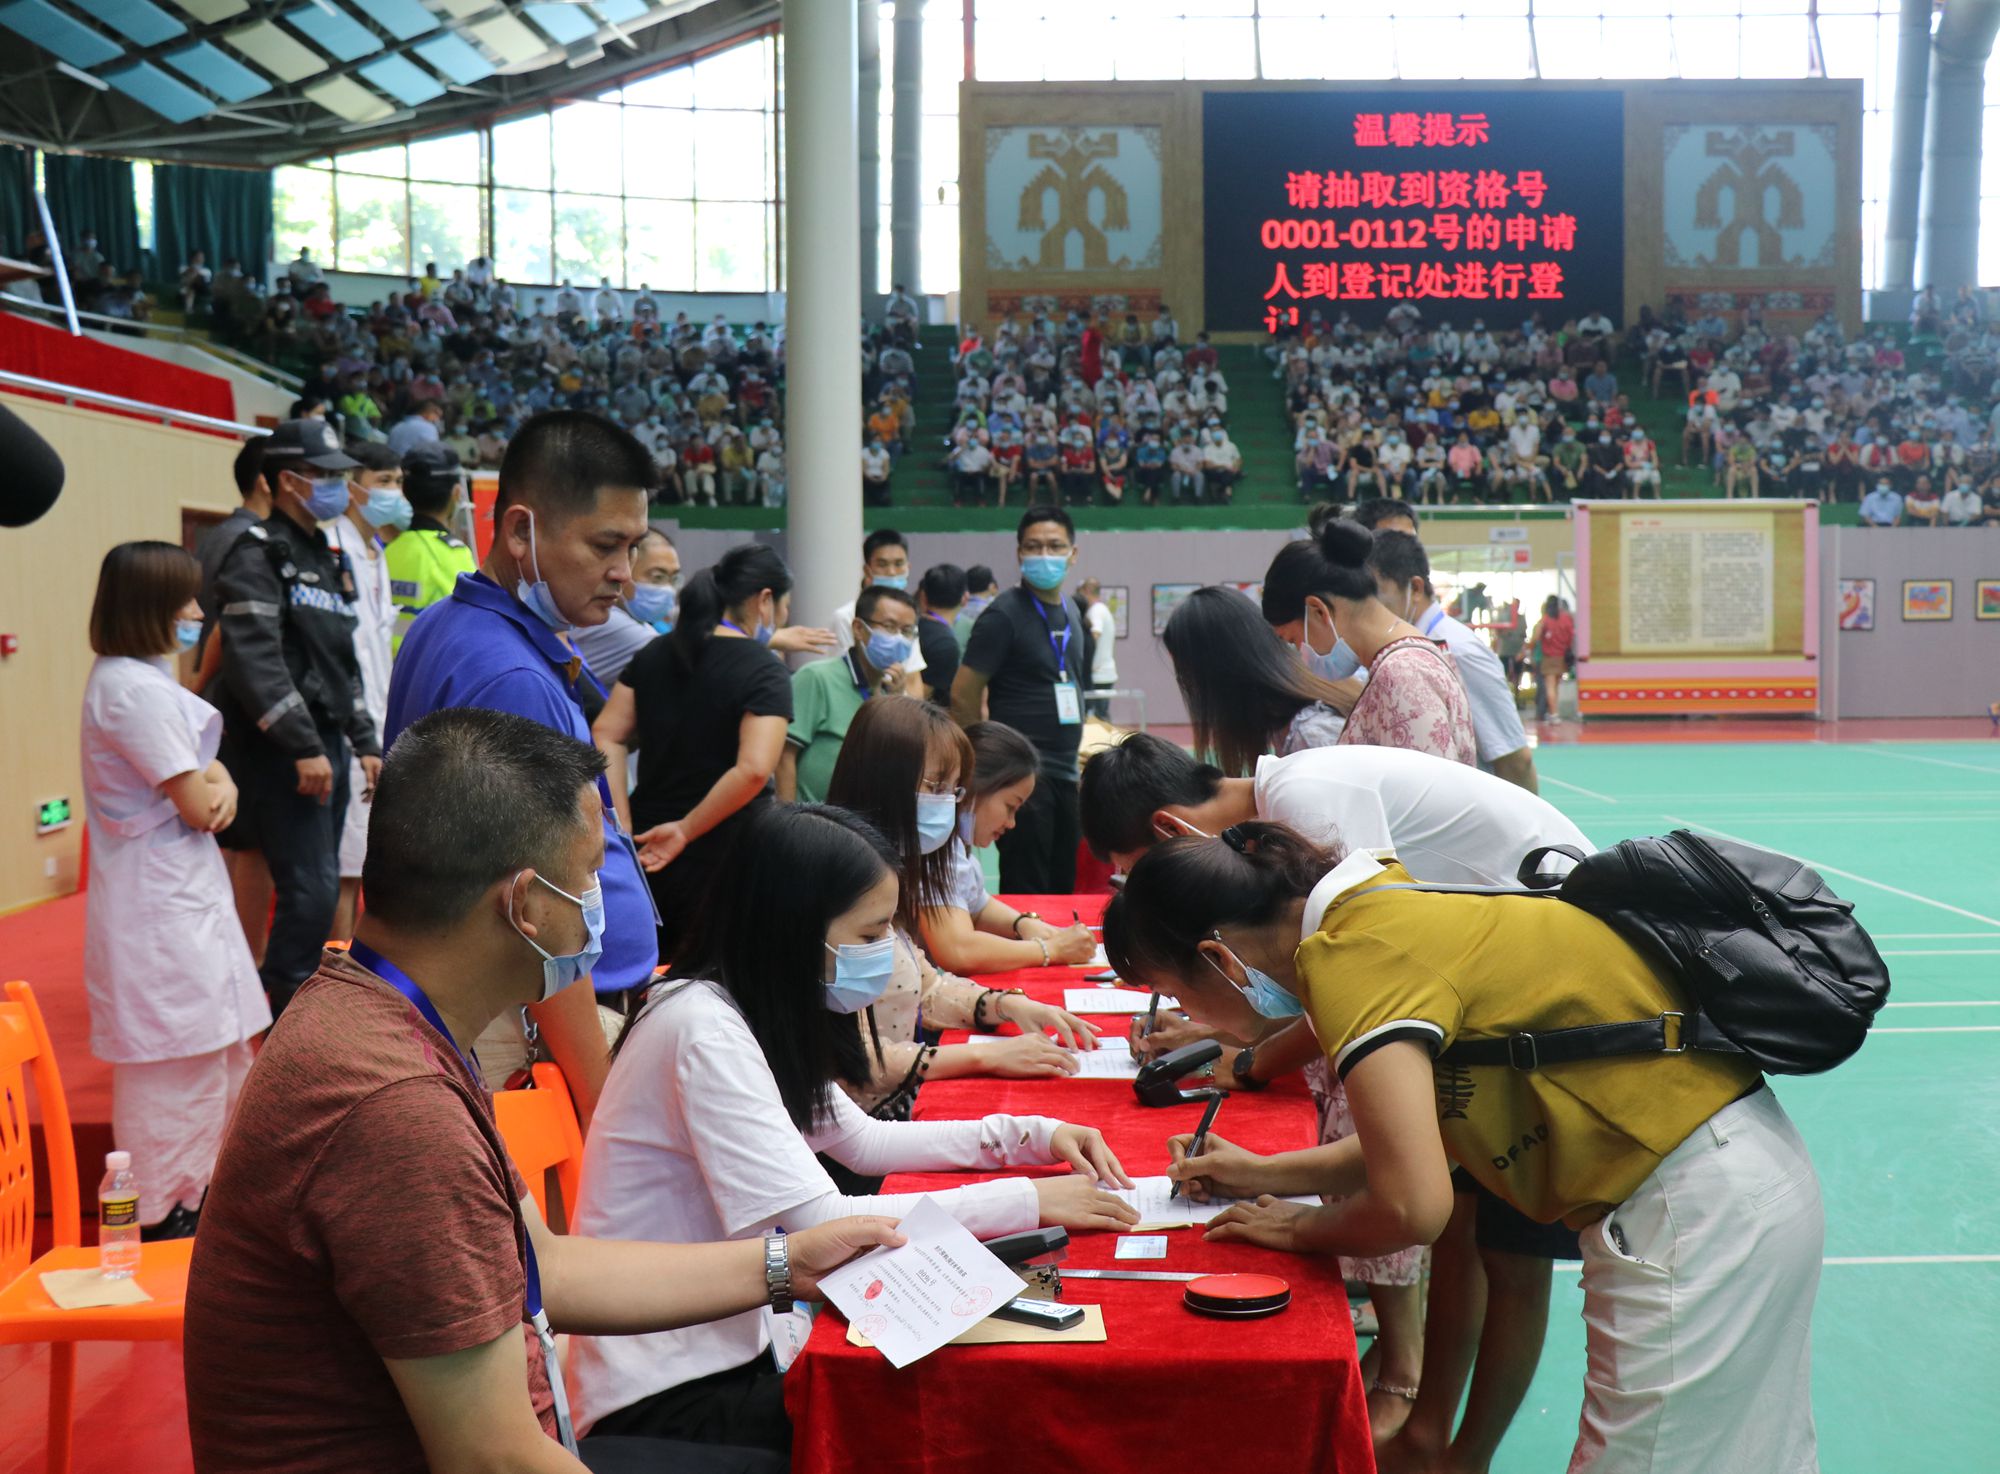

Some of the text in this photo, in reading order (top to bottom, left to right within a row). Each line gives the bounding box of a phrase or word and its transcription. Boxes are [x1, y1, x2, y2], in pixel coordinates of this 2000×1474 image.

[1354, 113, 1489, 147] 温馨提示
[1286, 170, 1547, 208] 请抽取到资格号
[1261, 213, 1578, 251] 0001-0112号的申请
[1264, 262, 1563, 299] 人到登记处进行登
